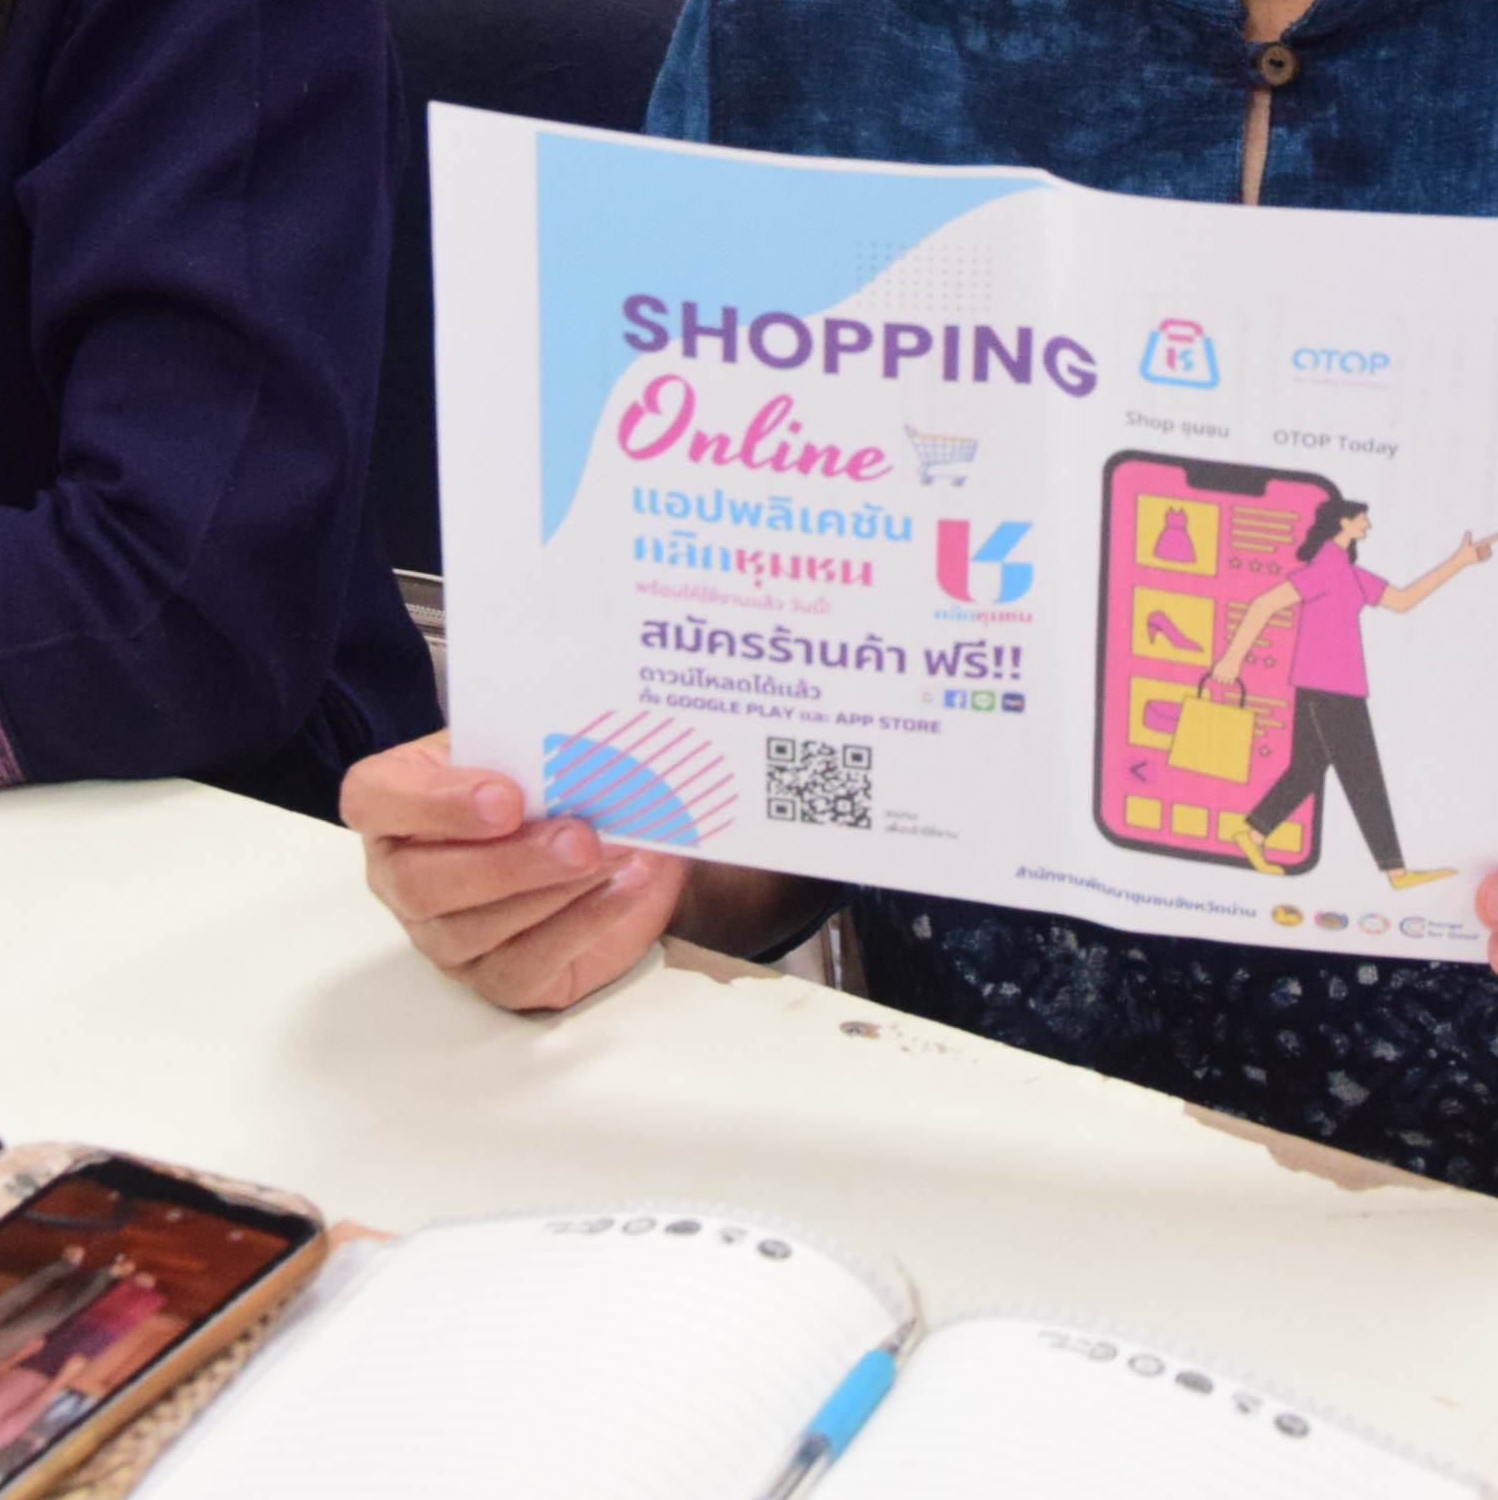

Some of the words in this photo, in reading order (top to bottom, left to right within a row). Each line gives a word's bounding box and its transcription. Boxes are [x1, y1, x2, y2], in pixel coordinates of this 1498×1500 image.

[622, 293, 1098, 398] SHOPPING
[1292, 347, 1390, 375] OTOP
[617, 373, 895, 482] Online
[1125, 410, 1175, 434] Shop
[1273, 429, 1331, 449] OTOP
[1337, 434, 1399, 460] Today
[632, 485, 914, 543] แอปพลิเคชัน
[639, 615, 907, 675] สมัครร้านค้า
[923, 639, 1023, 681] ฟรี!!
[666, 692, 741, 714] GOOGLE
[746, 703, 795, 719] PLAY
[835, 711, 875, 727] APP
[879, 715, 942, 734] STORE
